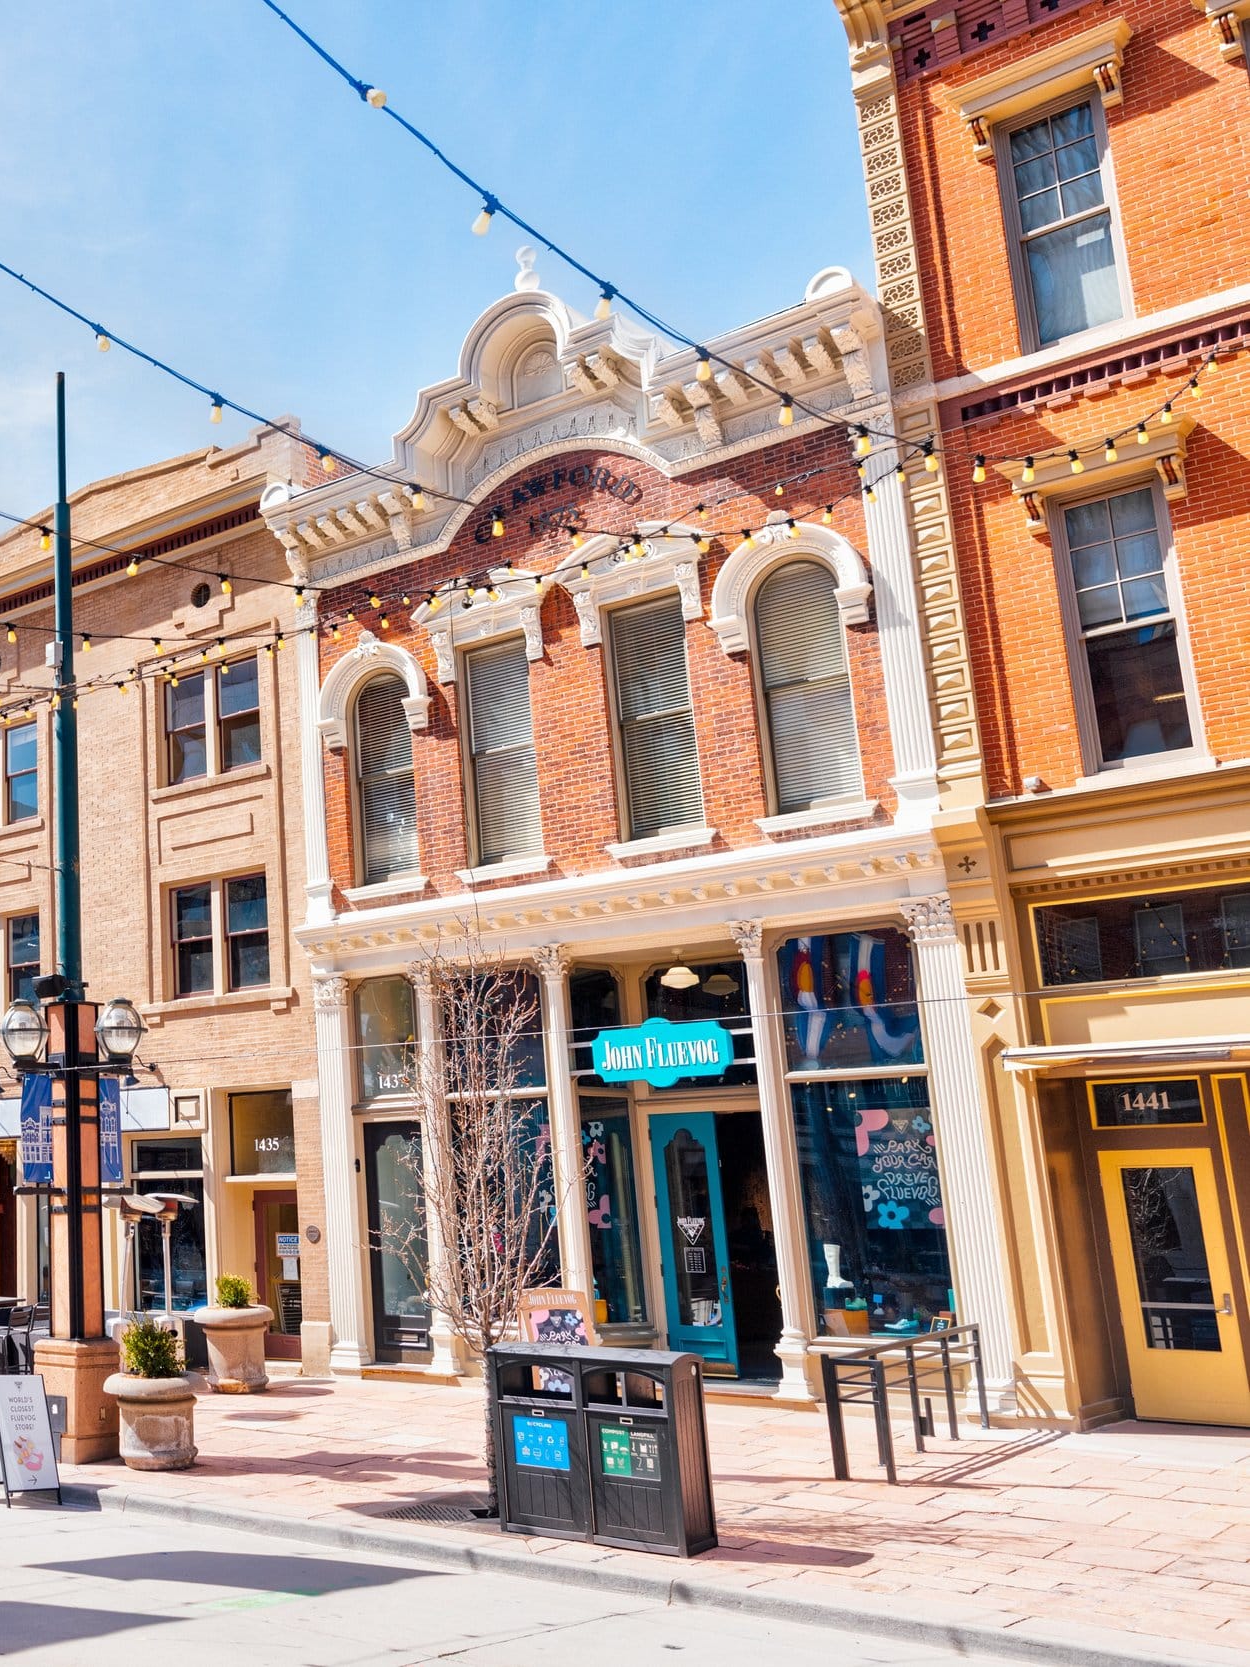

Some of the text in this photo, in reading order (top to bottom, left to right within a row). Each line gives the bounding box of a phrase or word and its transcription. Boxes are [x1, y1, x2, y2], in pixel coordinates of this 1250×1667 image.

[474, 464, 638, 544] CAWFORD
[601, 1036, 719, 1071] JOHN FLUEVOG
[1121, 1091, 1171, 1111] 1441
[254, 1137, 280, 1152] 1435
[882, 1139, 932, 1154] PARK
[872, 1153, 939, 1173] YOUR CAR
[884, 1171, 930, 1186] DRIVE
[877, 1176, 939, 1200] FLUEVOG
[528, 1291, 577, 1305] JOHN FLUEVOG
[547, 1330, 580, 1341] PARK
